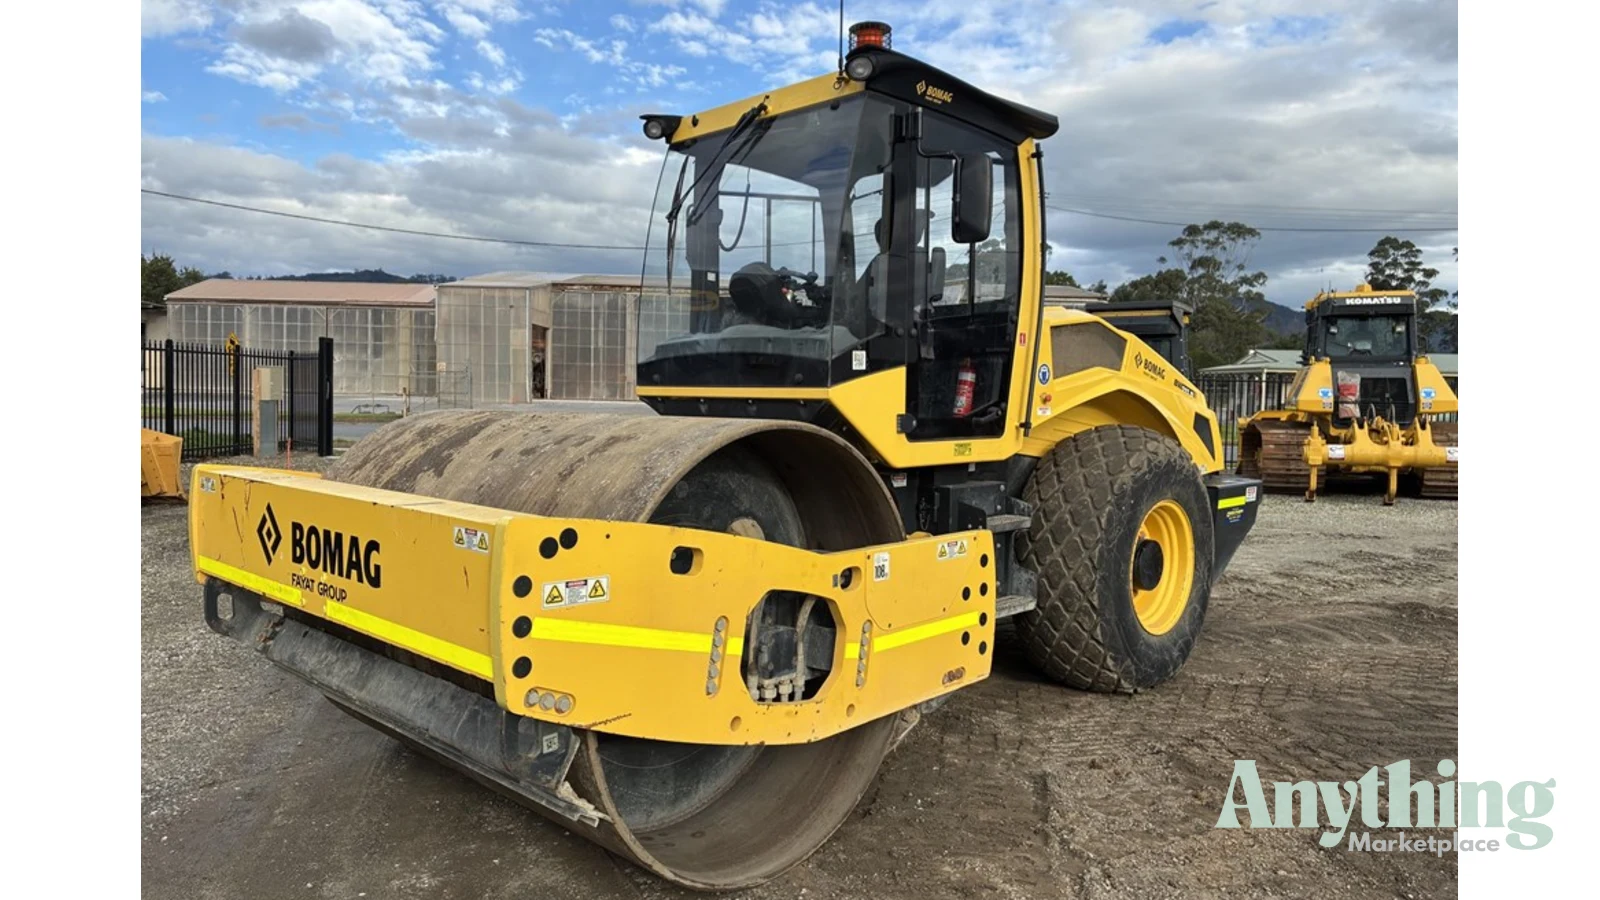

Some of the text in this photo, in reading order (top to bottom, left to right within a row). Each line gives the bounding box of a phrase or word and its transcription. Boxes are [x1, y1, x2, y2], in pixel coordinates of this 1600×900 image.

[926, 85, 953, 103] BOMAG
[1345, 296, 1401, 305] KOMATSU
[1143, 358, 1166, 380] BOMAG
[291, 521, 381, 589] BOMAG
[291, 573, 348, 602] FAYAT GROUP
